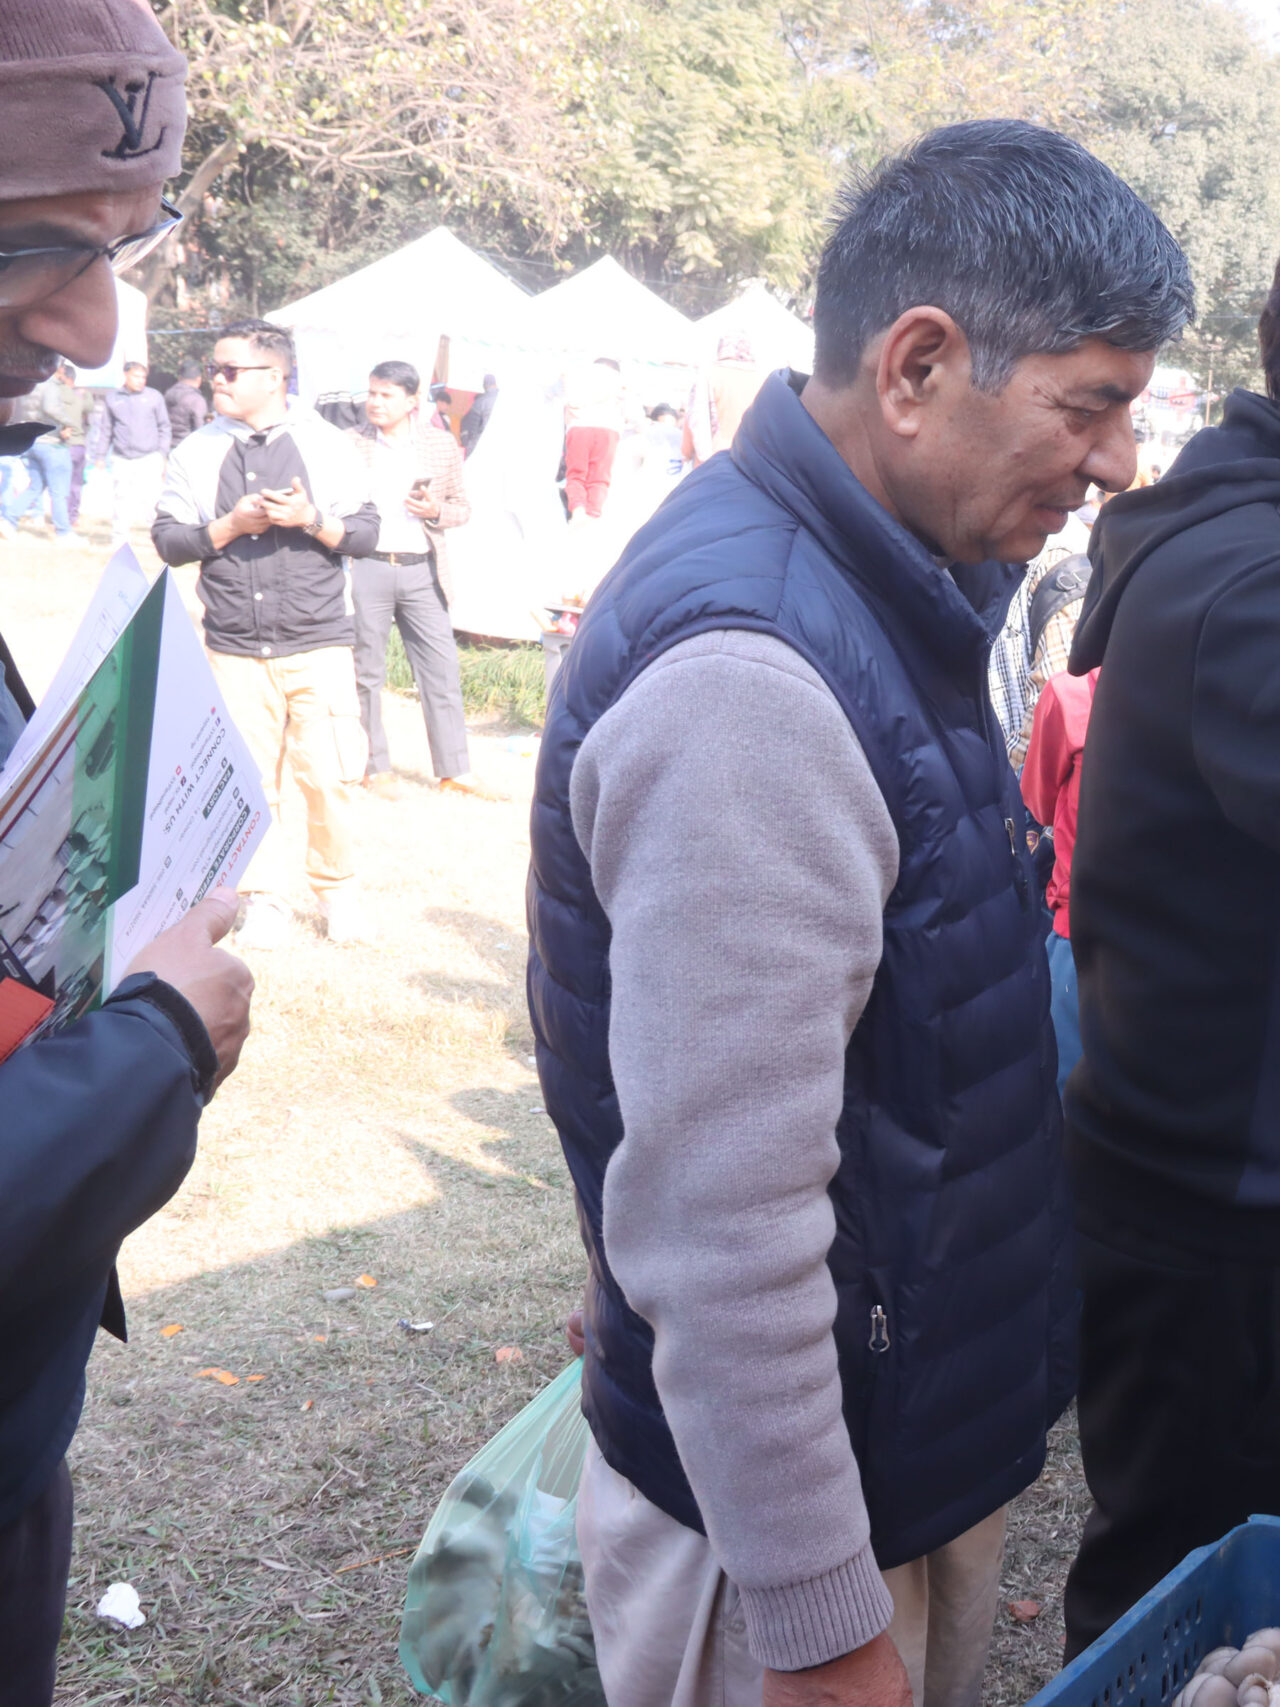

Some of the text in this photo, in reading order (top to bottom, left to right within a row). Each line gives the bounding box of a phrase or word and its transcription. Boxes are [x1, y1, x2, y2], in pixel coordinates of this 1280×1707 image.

[193, 726, 226, 782] CONNECT
[174, 781, 195, 815] WITH
[206, 769, 231, 812] FACTORY
[212, 810, 247, 871] CORPORATE
[227, 809, 261, 870] CONTACT
